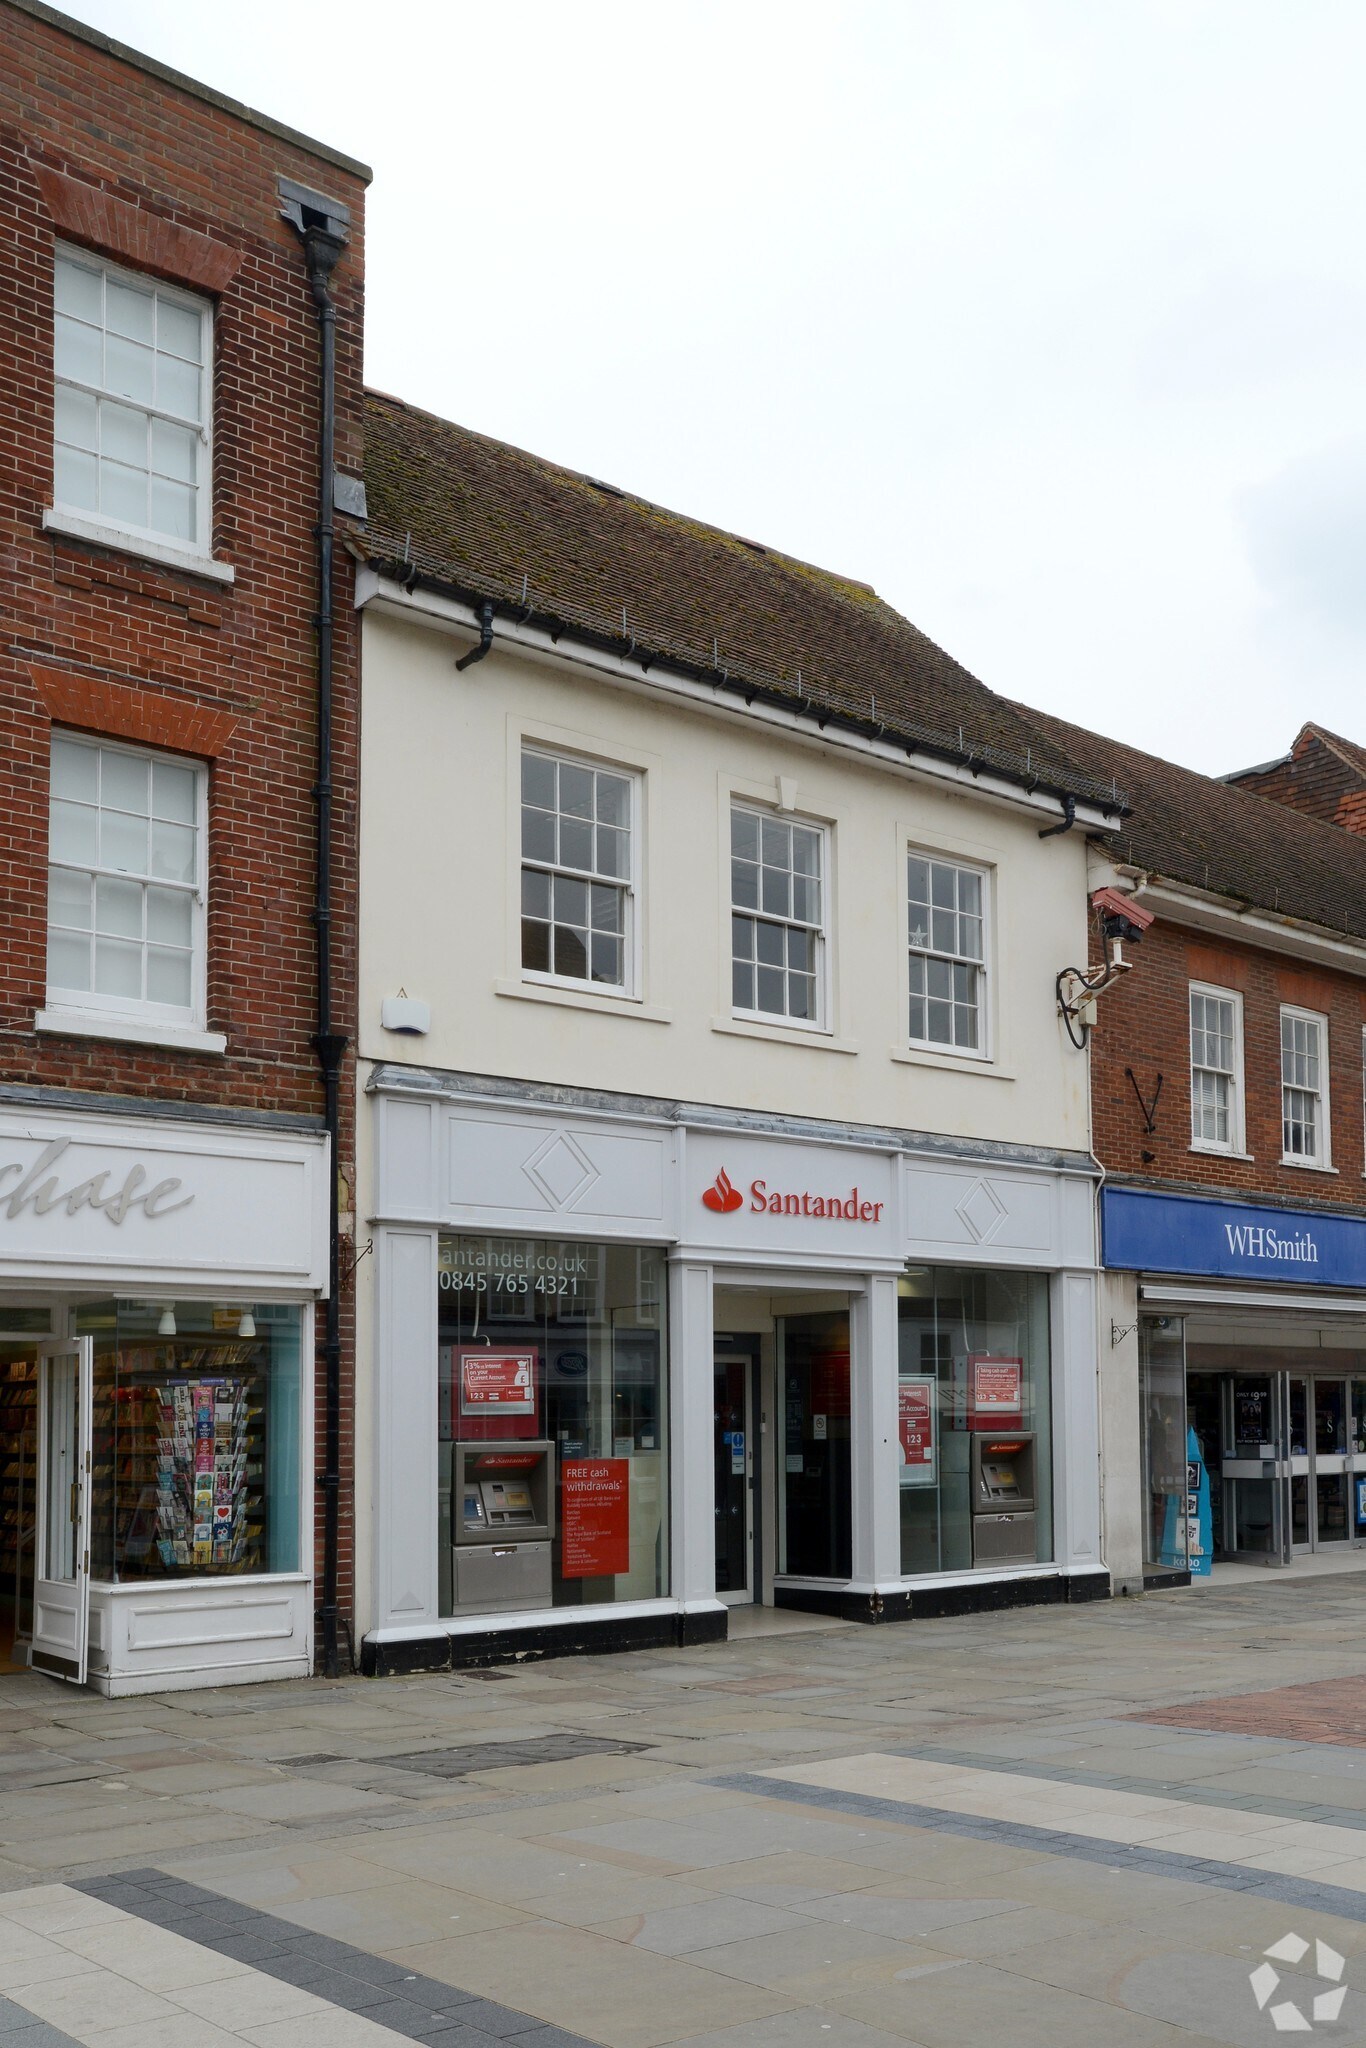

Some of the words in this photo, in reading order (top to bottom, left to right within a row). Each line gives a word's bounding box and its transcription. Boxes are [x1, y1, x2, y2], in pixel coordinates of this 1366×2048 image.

[750, 1180, 884, 1222] Santander
[1224, 1224, 1319, 1262] WHSmith
[439, 1270, 487, 1292] 0845
[494, 1273, 529, 1294] 765
[535, 1275, 577, 1296] 4321
[495, 1456, 533, 1464] Santander
[566, 1468, 588, 1478] FREE
[590, 1467, 609, 1477] cash
